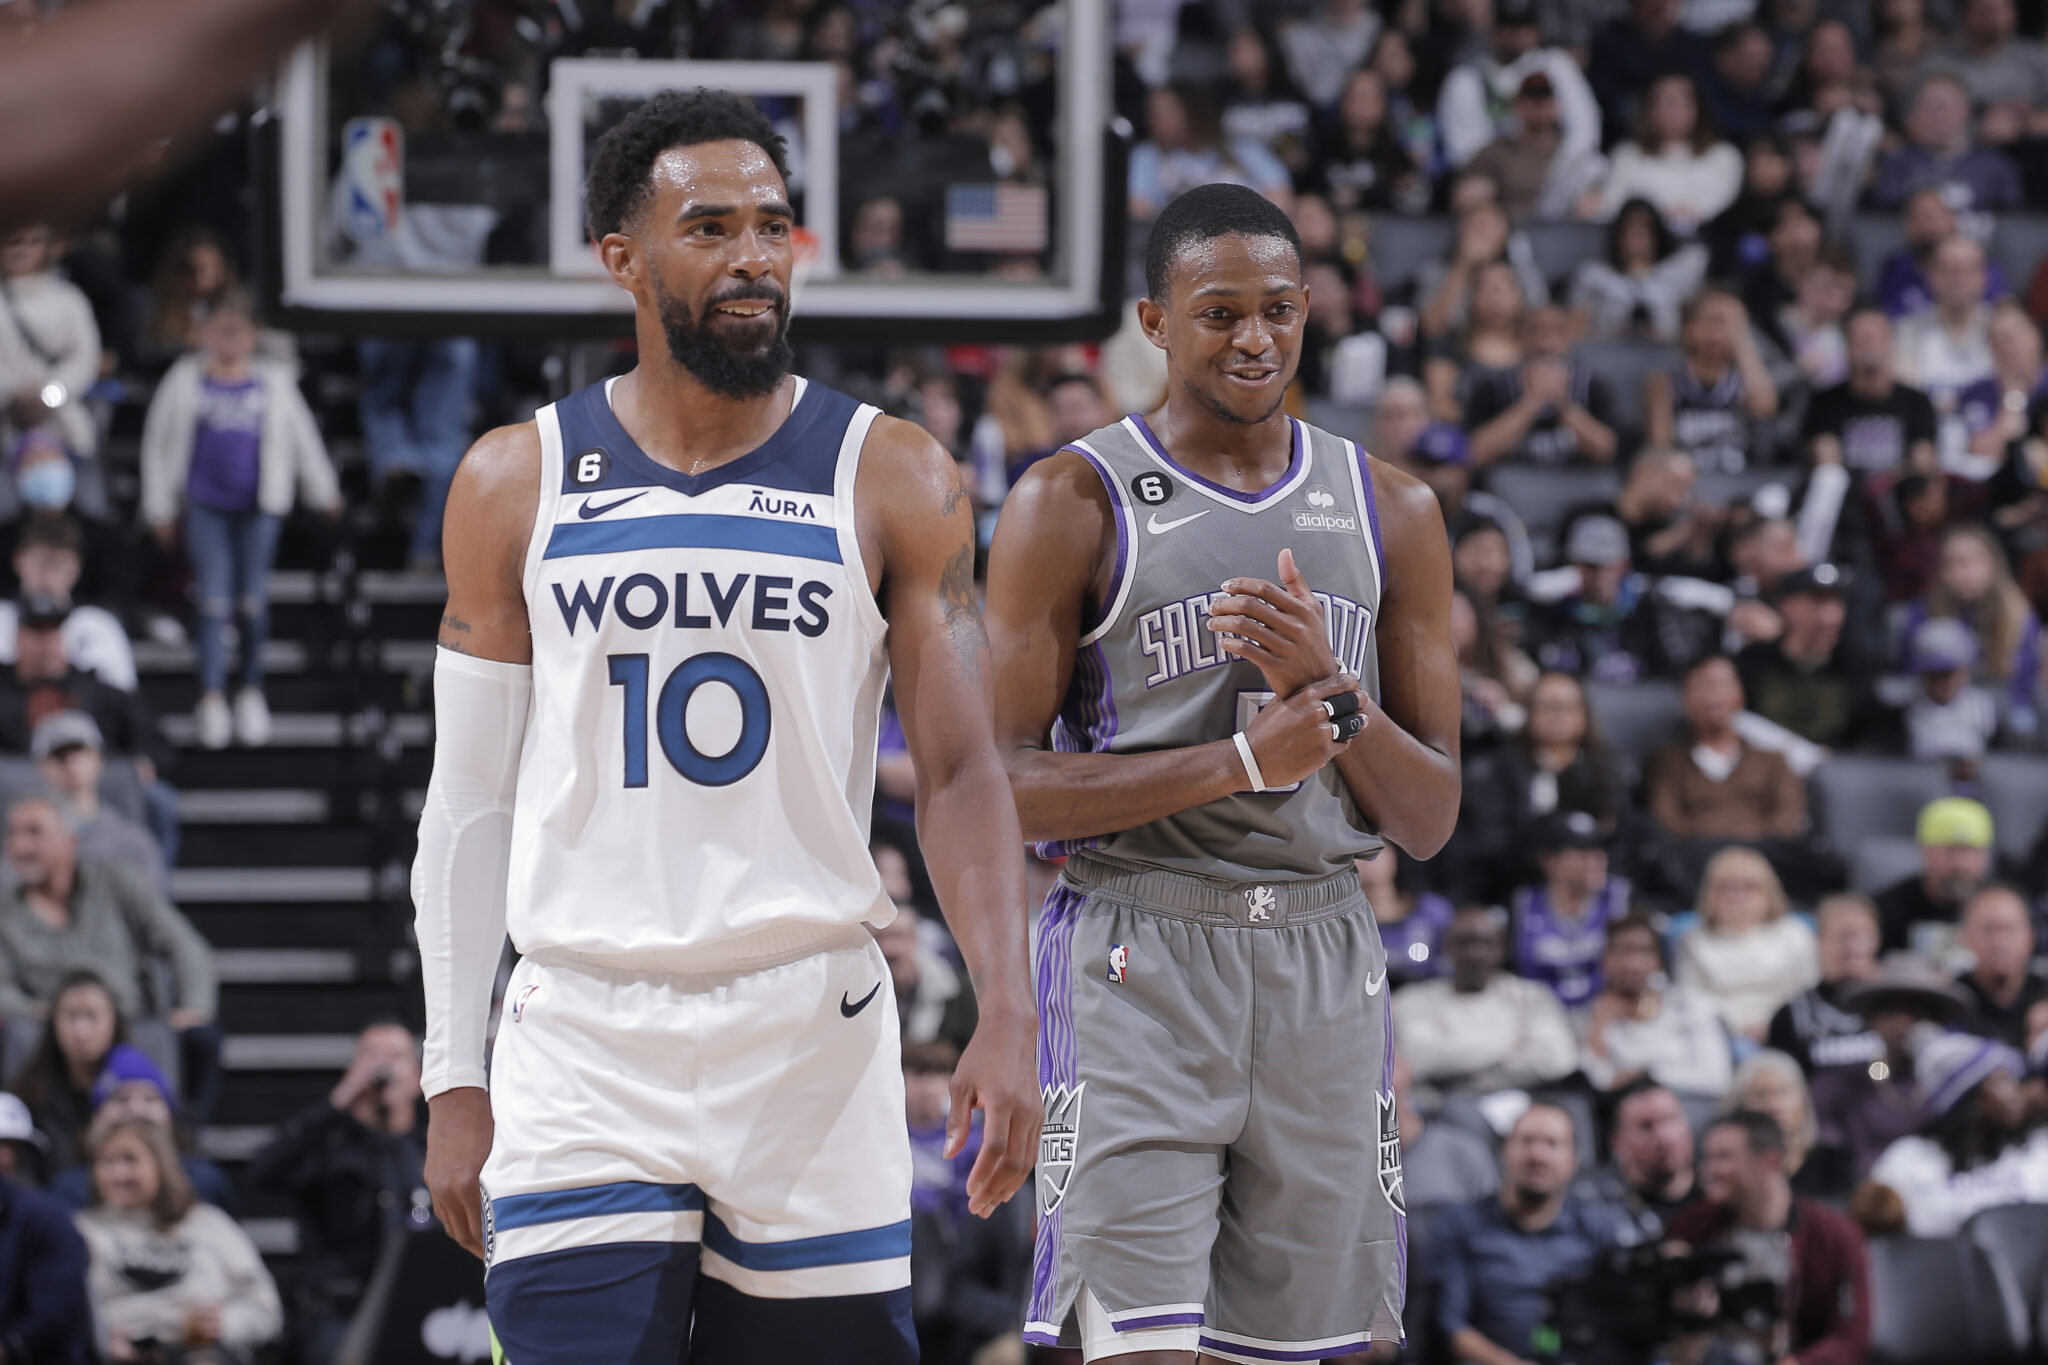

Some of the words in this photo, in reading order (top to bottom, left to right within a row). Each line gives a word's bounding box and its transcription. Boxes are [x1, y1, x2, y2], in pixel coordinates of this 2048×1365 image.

[577, 453, 602, 483] 6
[1139, 476, 1165, 502] 6
[1295, 513, 1356, 530] dialpad
[551, 572, 834, 638] WOLVES
[606, 651, 772, 789] 10
